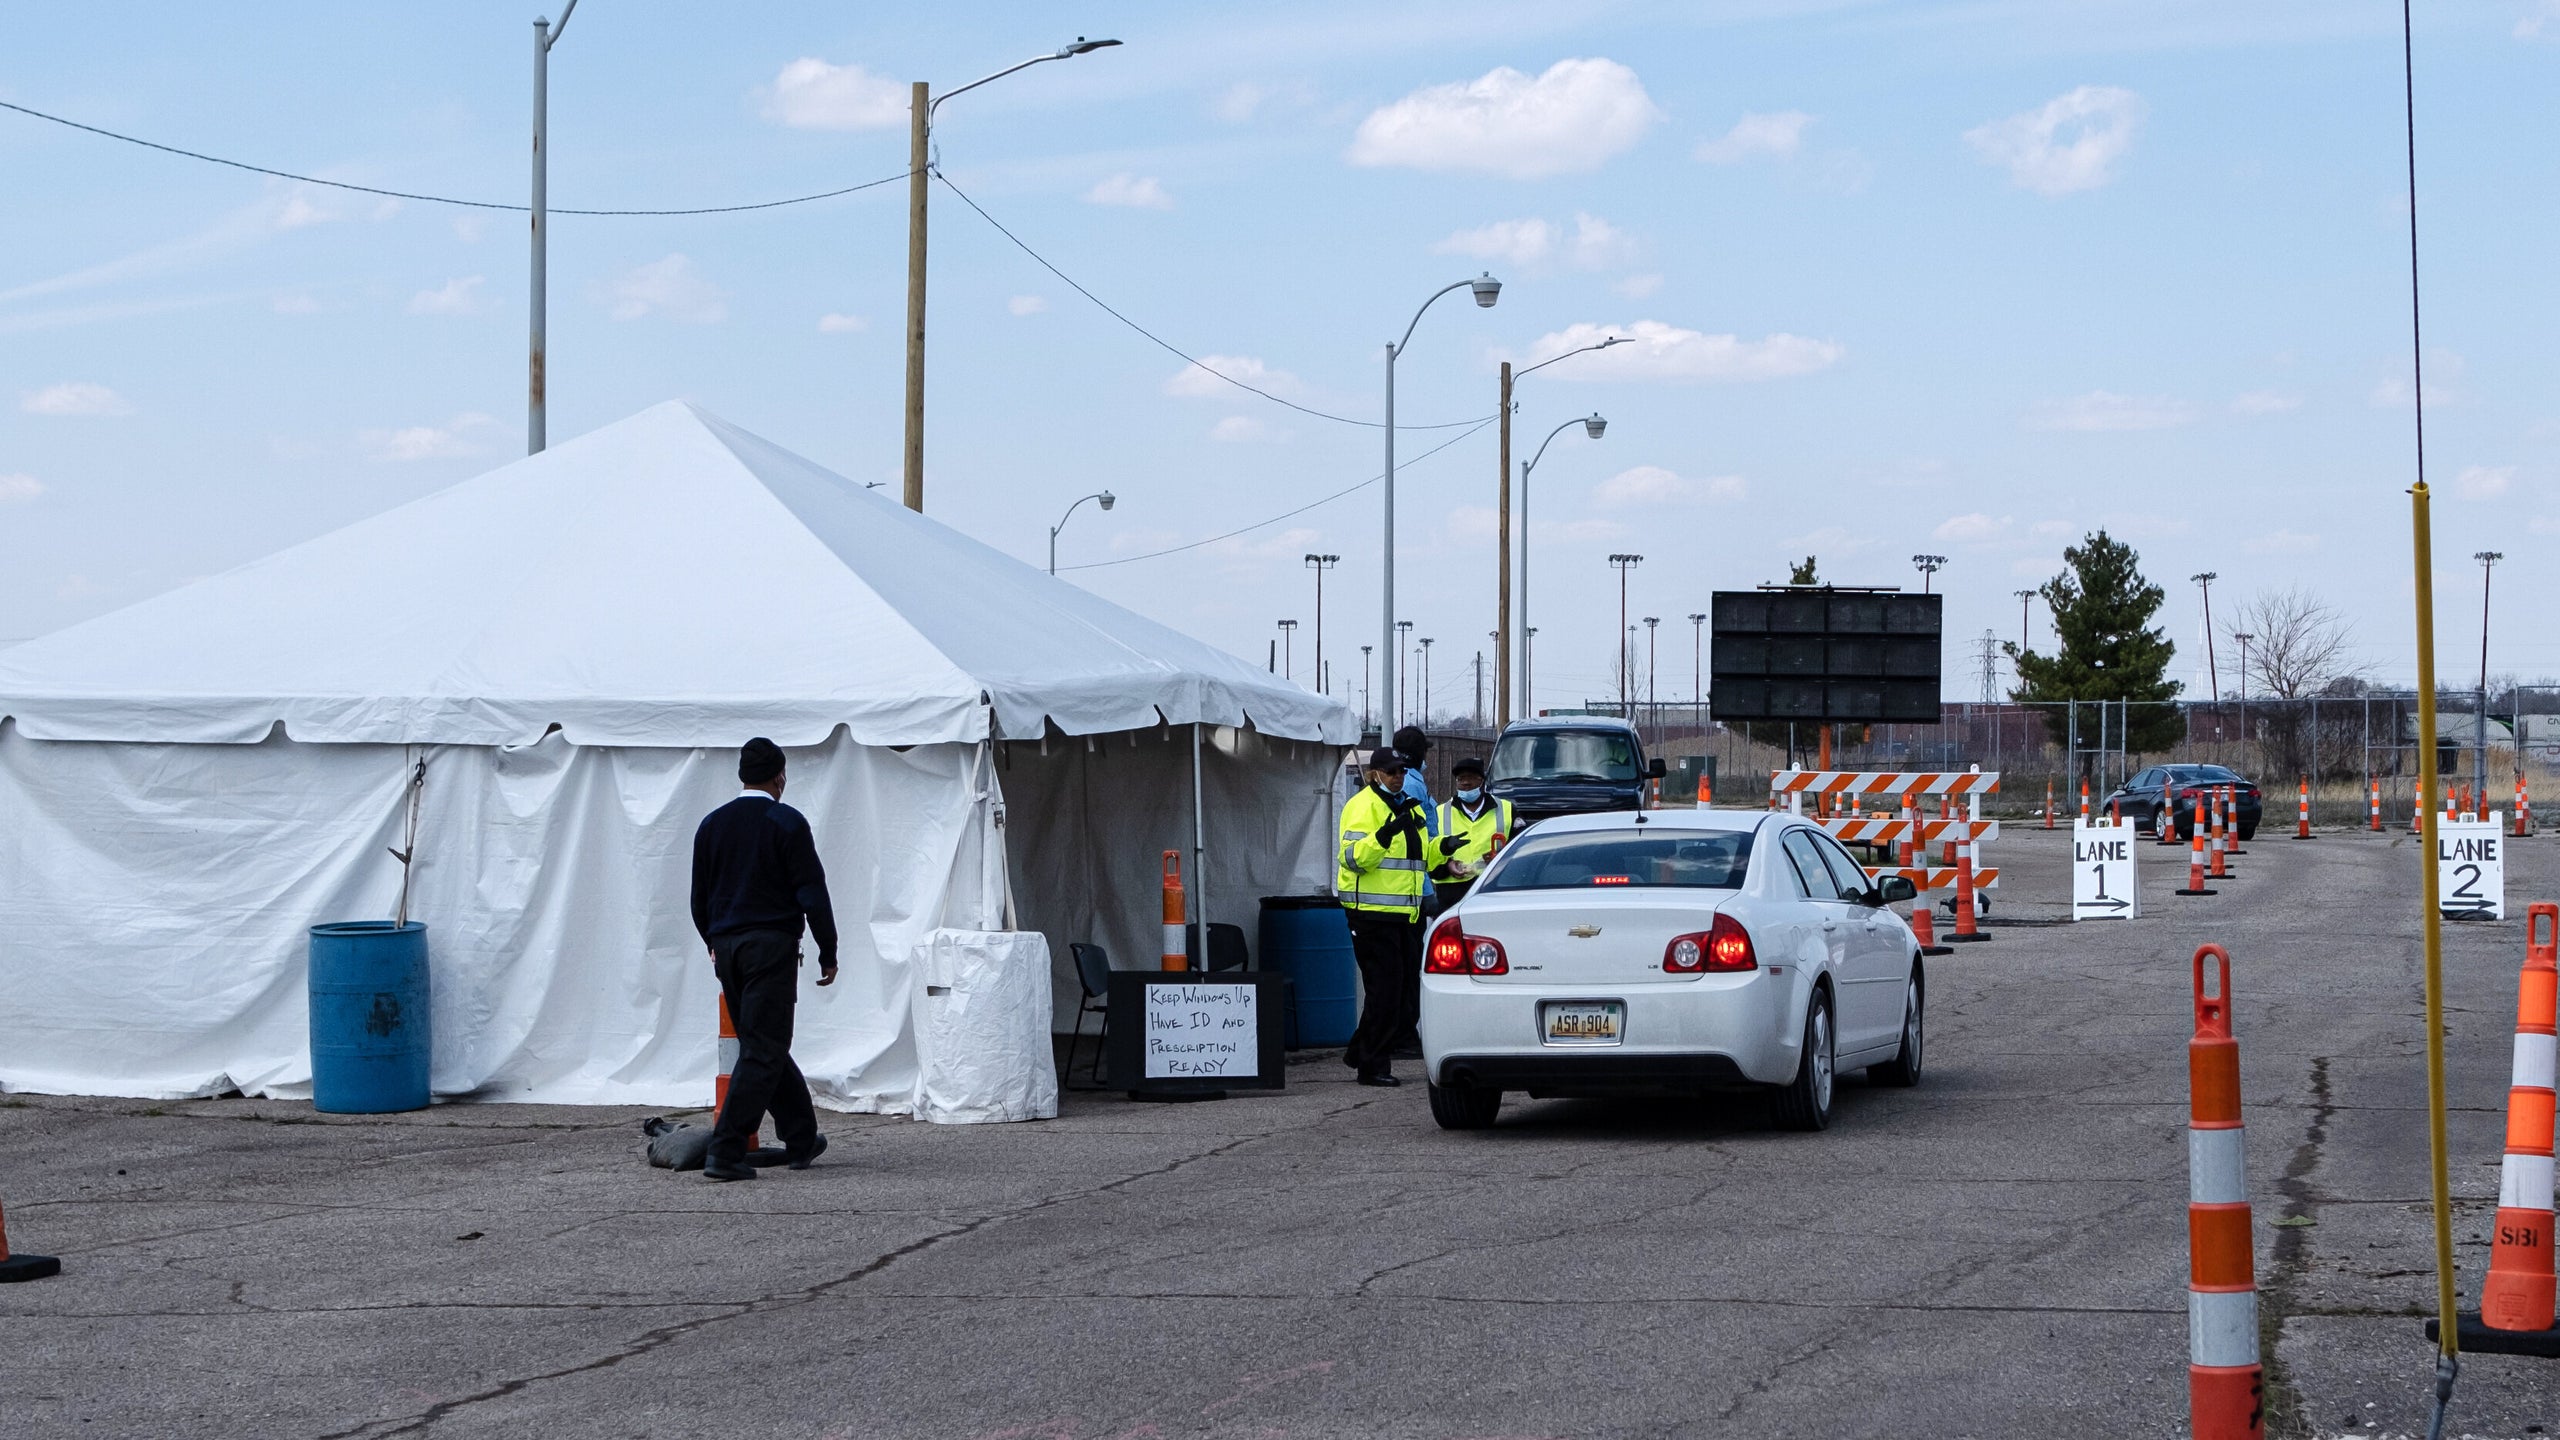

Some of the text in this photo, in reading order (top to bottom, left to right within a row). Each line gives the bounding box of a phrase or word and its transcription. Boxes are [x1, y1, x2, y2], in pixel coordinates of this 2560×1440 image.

[2076, 841, 2128, 862] LANE
[2439, 838, 2497, 861] LANE
[2092, 863, 2109, 900] 1
[2452, 863, 2484, 898] 2
[1150, 986, 1181, 1006] KEEP
[1150, 1011, 1246, 1031] HAVE ID AND
[1556, 1015, 1610, 1032] ASR 904
[1150, 1038, 1236, 1055] PRESCRIPTION
[1169, 1058, 1228, 1075] READY
[2500, 1226, 2538, 1247] SBI
